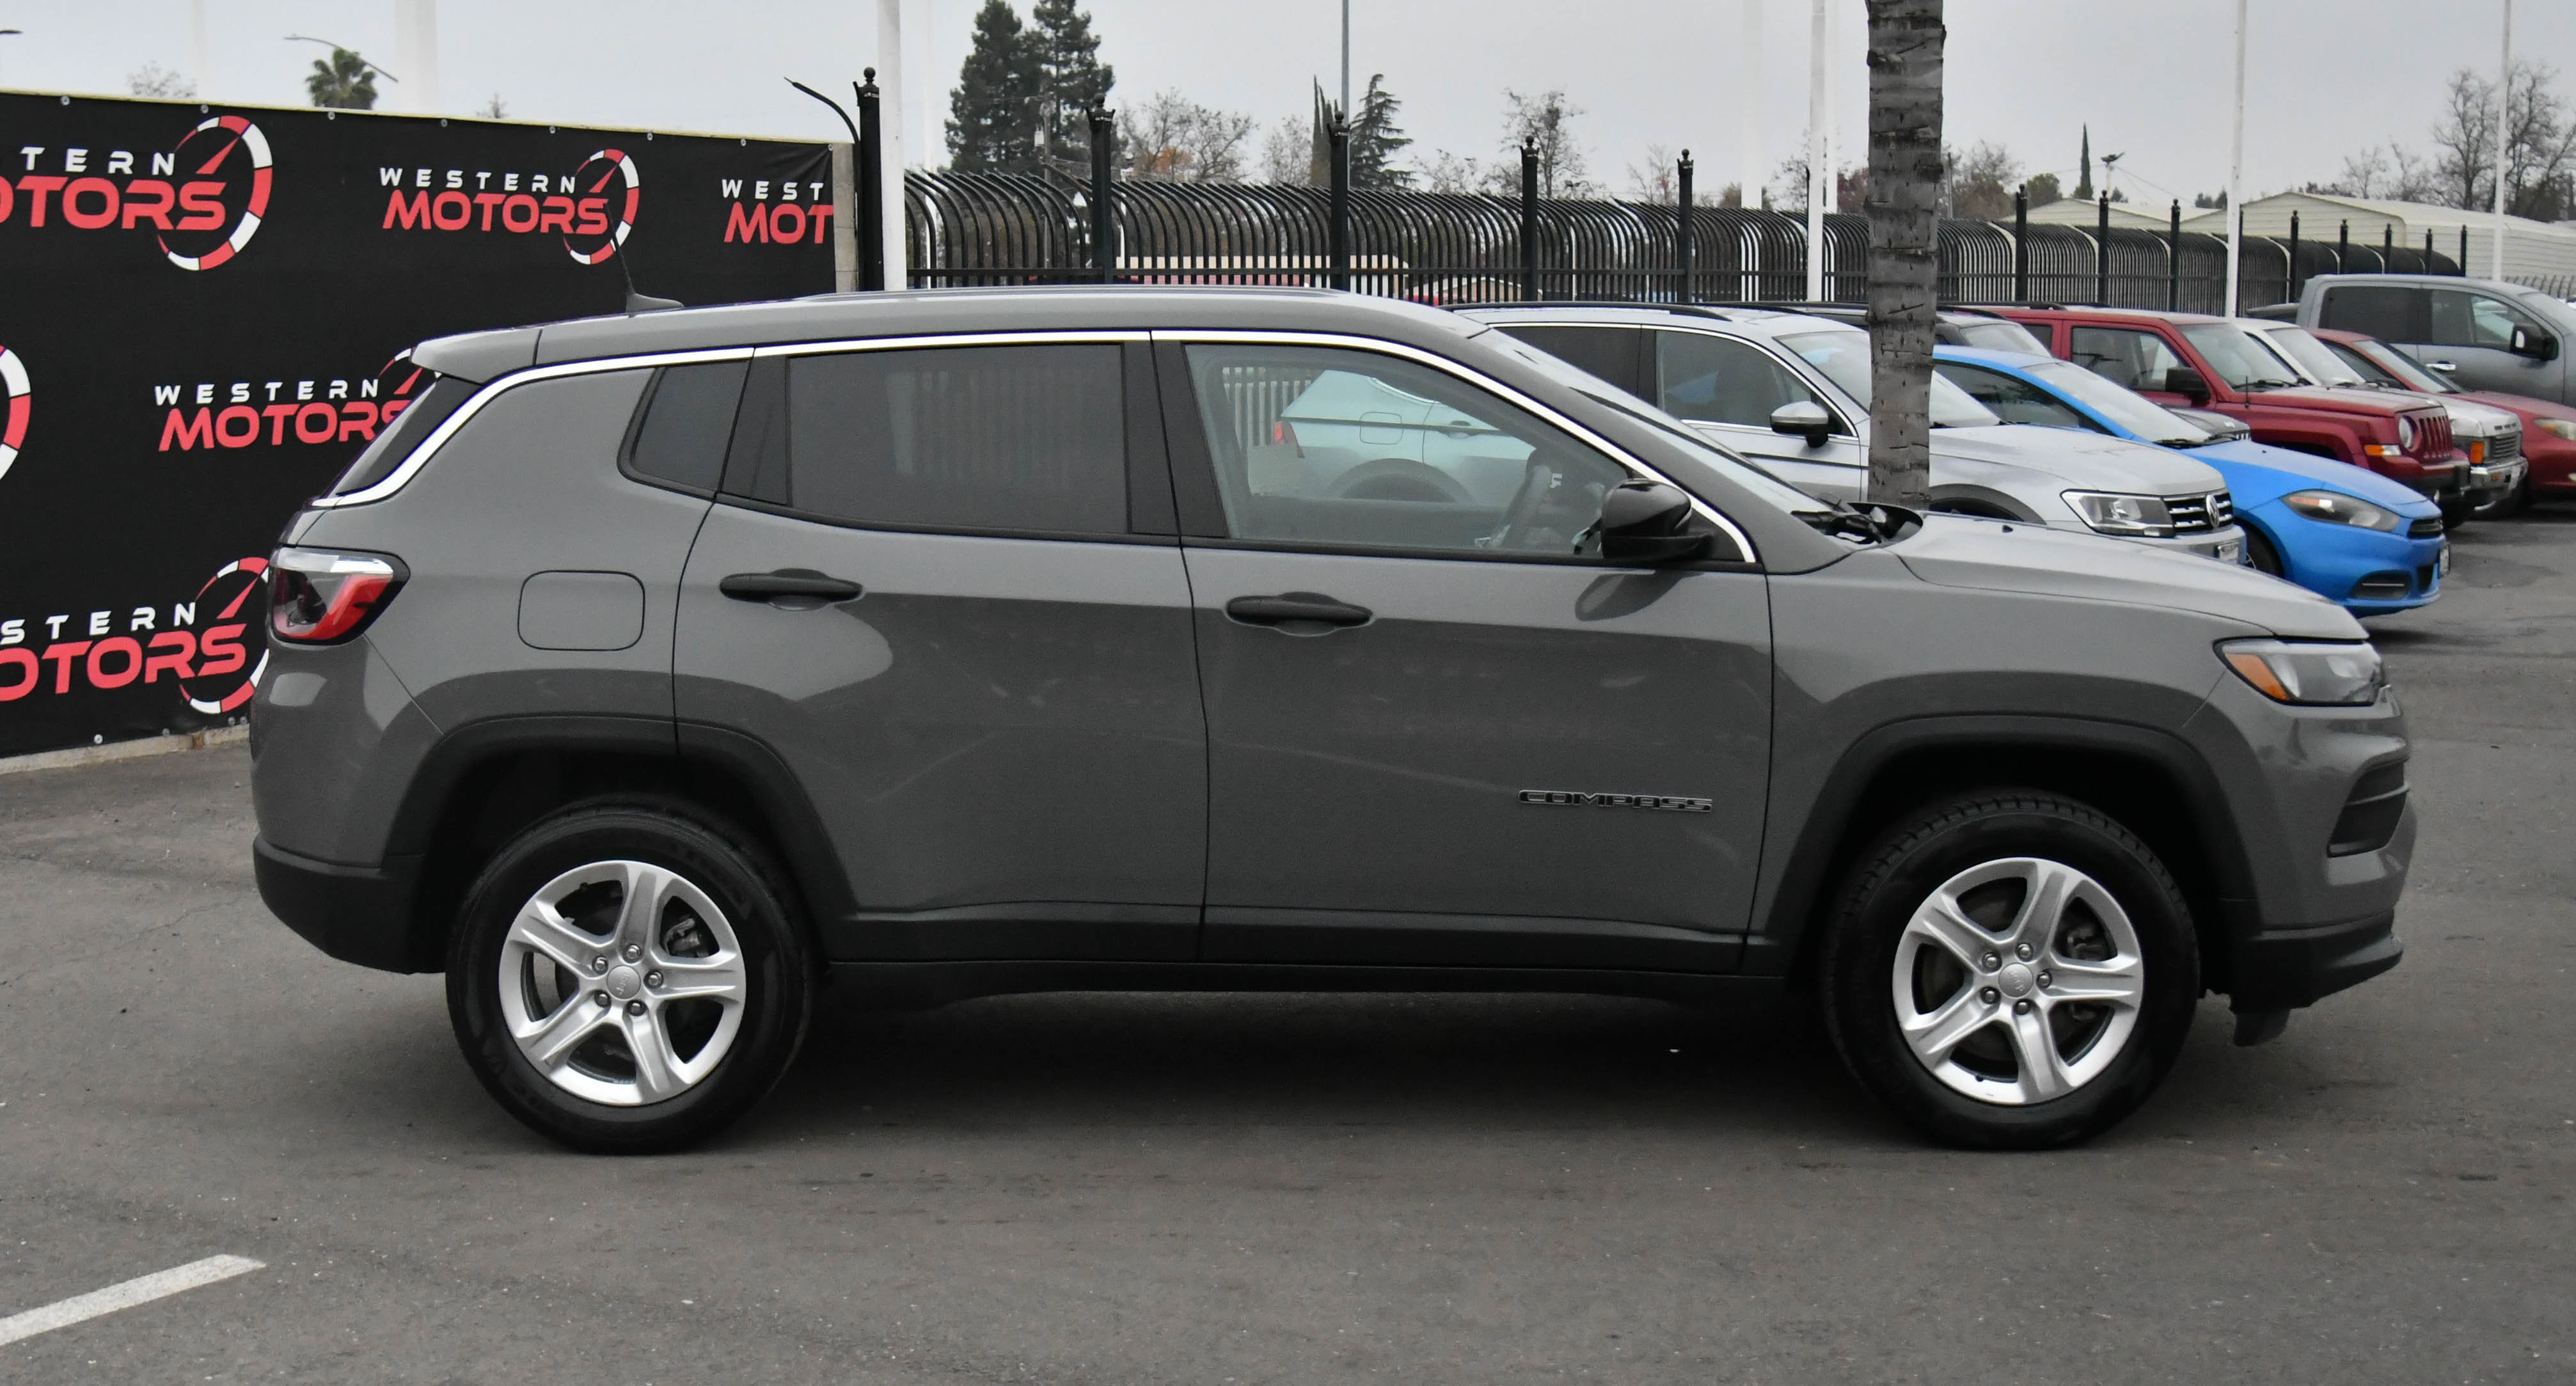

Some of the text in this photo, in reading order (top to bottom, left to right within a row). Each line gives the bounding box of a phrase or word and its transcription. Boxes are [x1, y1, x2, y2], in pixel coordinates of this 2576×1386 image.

[20, 146, 175, 176] TERN
[379, 167, 576, 194] WESTERN
[722, 178, 824, 201] WEST
[0, 175, 226, 231] TORS
[383, 187, 608, 235] MOTORS
[723, 201, 834, 244] MOT
[154, 379, 379, 406] WESTERN
[0, 602, 196, 645] STERN
[1518, 789, 1712, 812] COMPASS
